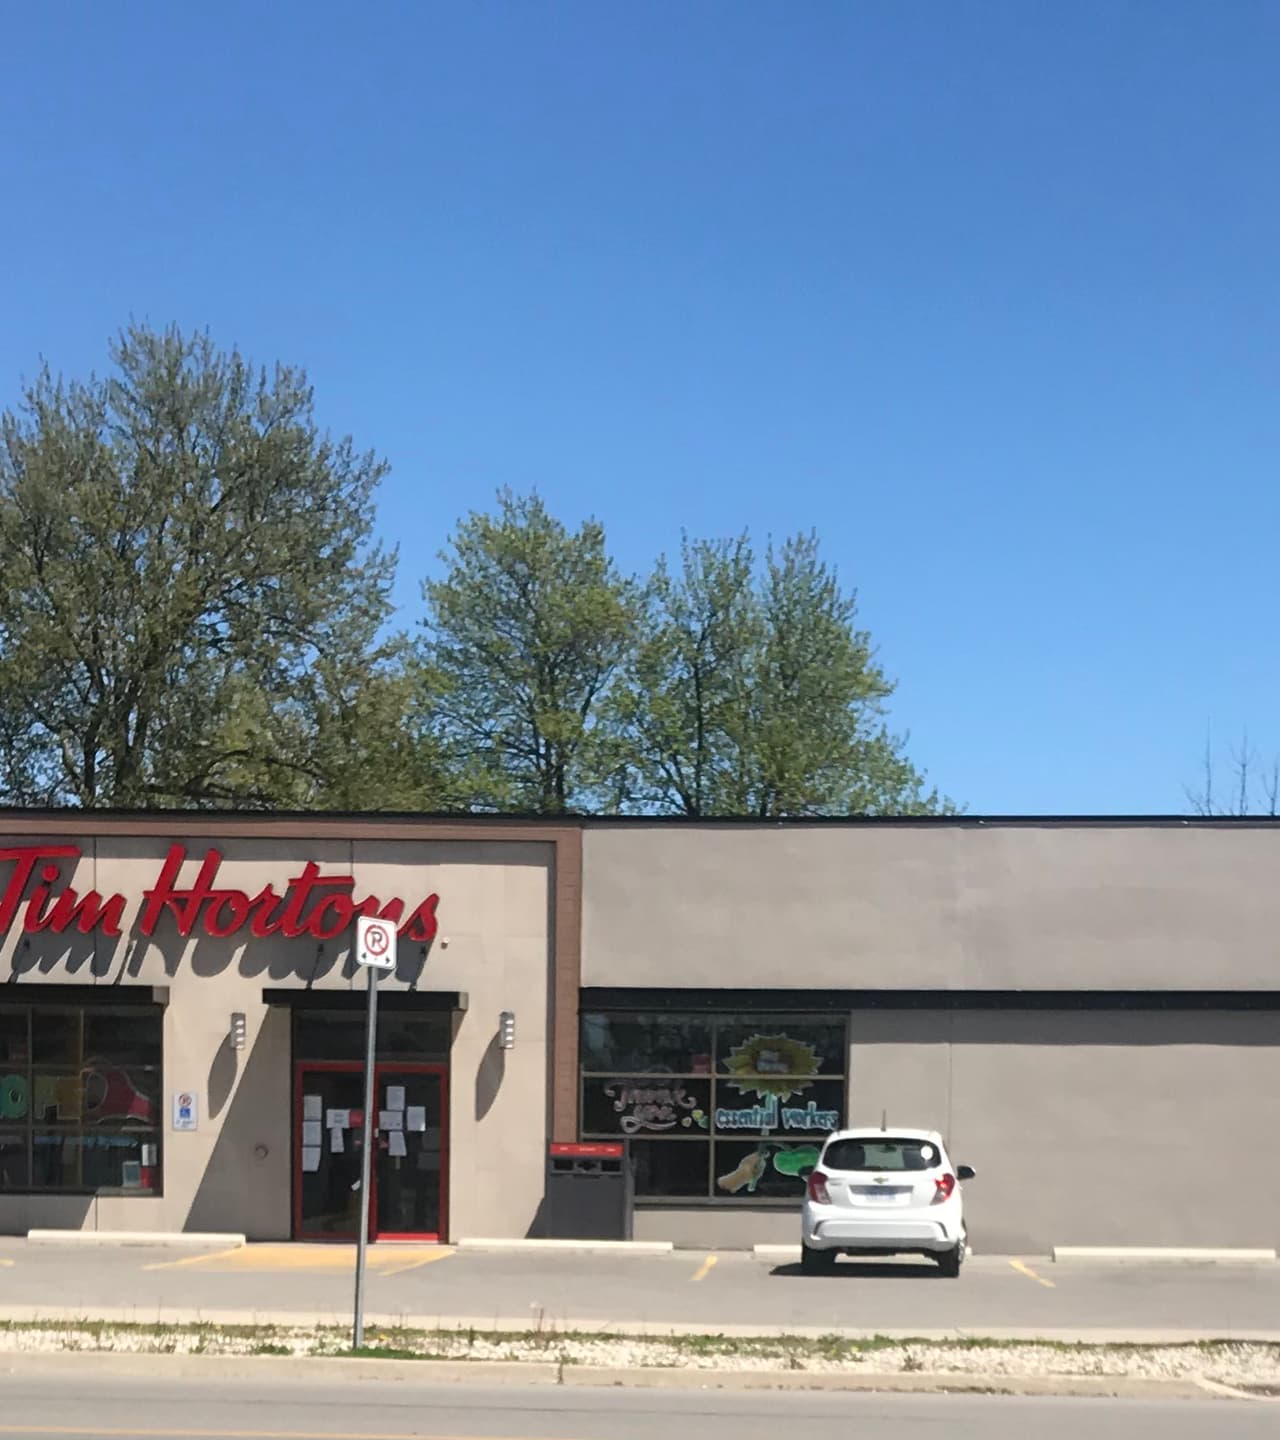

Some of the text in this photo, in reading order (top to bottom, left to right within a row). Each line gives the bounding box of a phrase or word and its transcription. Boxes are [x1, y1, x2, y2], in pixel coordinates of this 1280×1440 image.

[141, 843, 439, 941] Hortons
[716, 1098, 840, 1130] essential workers
